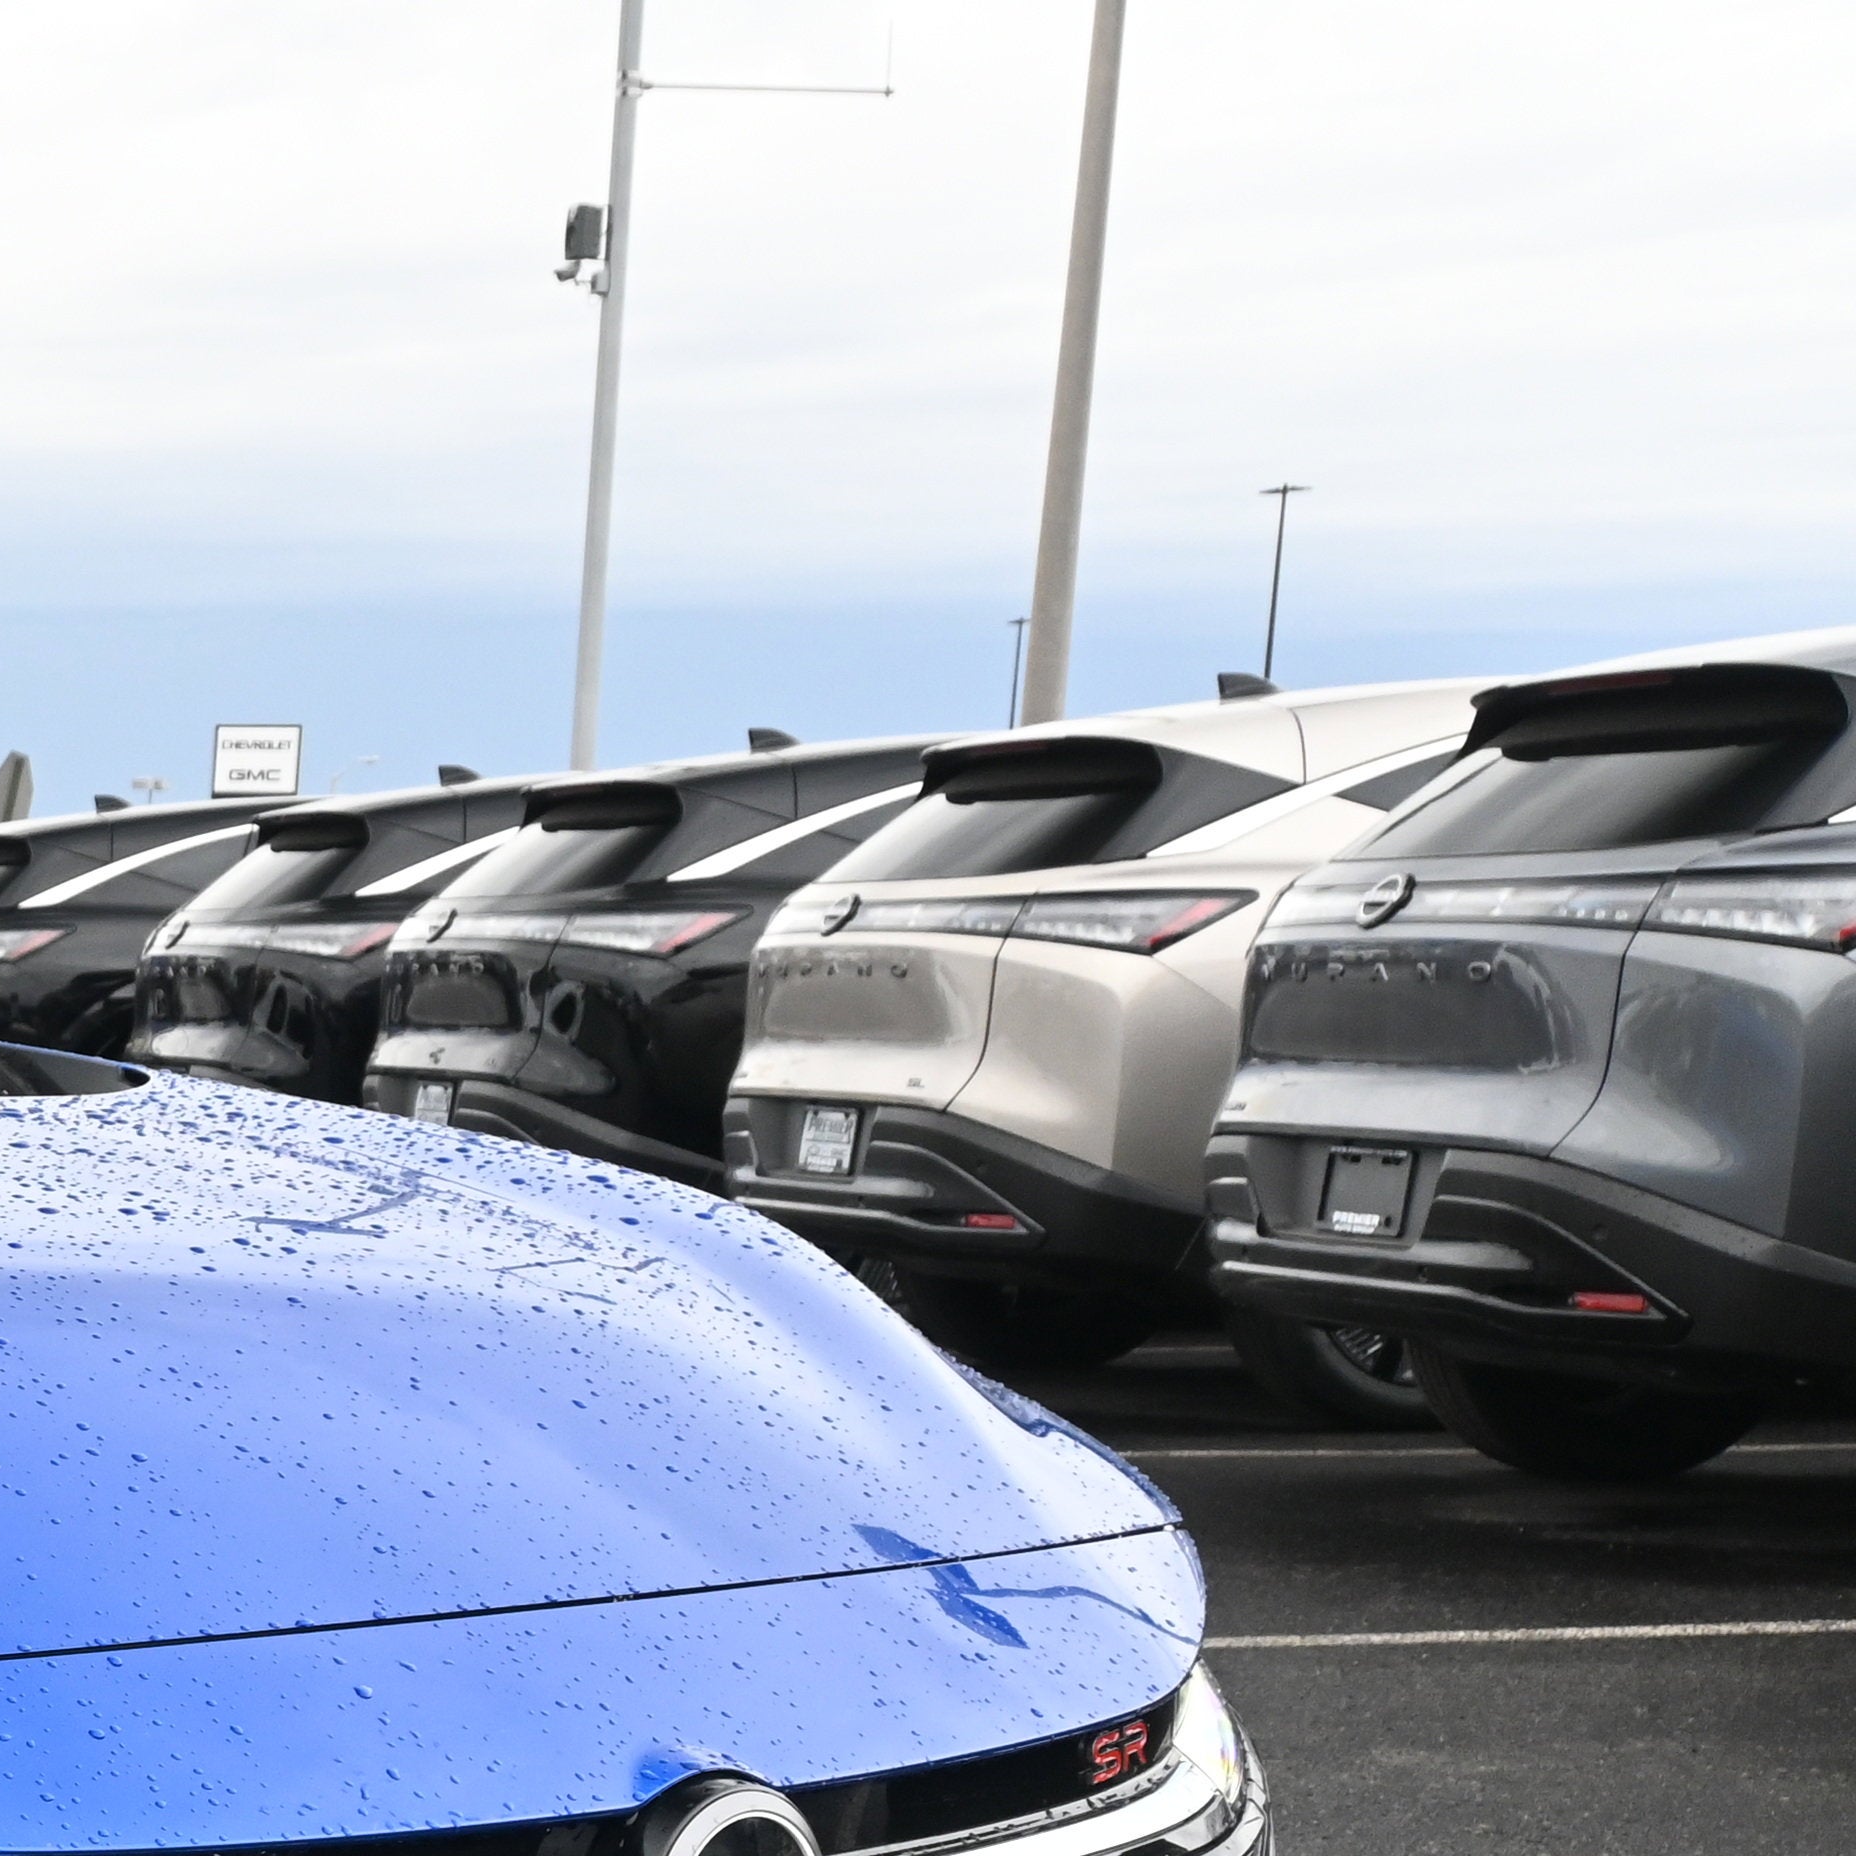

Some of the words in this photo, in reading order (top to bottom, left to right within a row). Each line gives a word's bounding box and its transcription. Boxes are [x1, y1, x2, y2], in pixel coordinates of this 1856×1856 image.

[221, 739, 292, 750] CHEVROLET
[228, 768, 282, 781] GMC
[1092, 1719, 1149, 1784] SR
